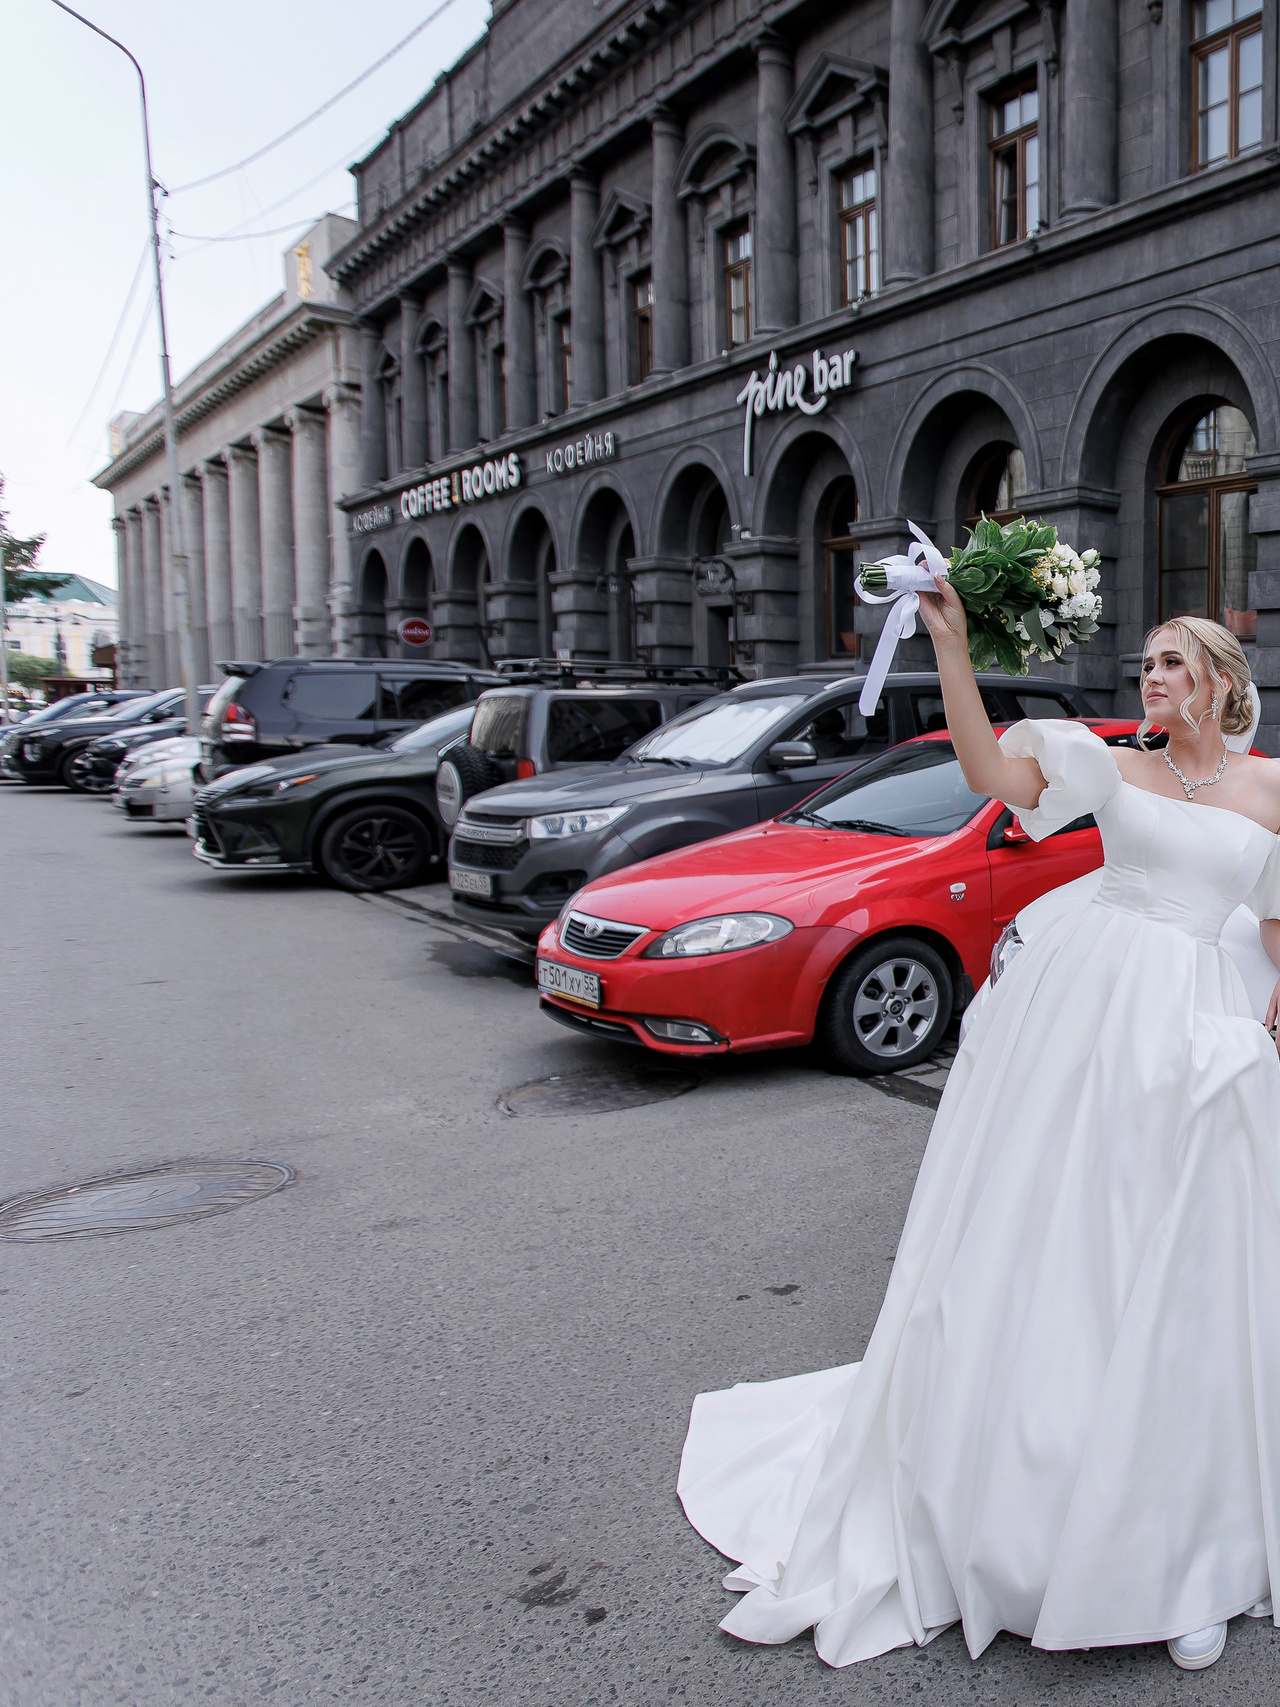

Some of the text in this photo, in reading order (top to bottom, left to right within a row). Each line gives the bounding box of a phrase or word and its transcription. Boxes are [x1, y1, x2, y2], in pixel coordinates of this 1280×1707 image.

[736, 349, 856, 477] pine bar
[401, 452, 520, 520] COFFEE ROOMS
[546, 431, 615, 475] КОФЕЙНЯ
